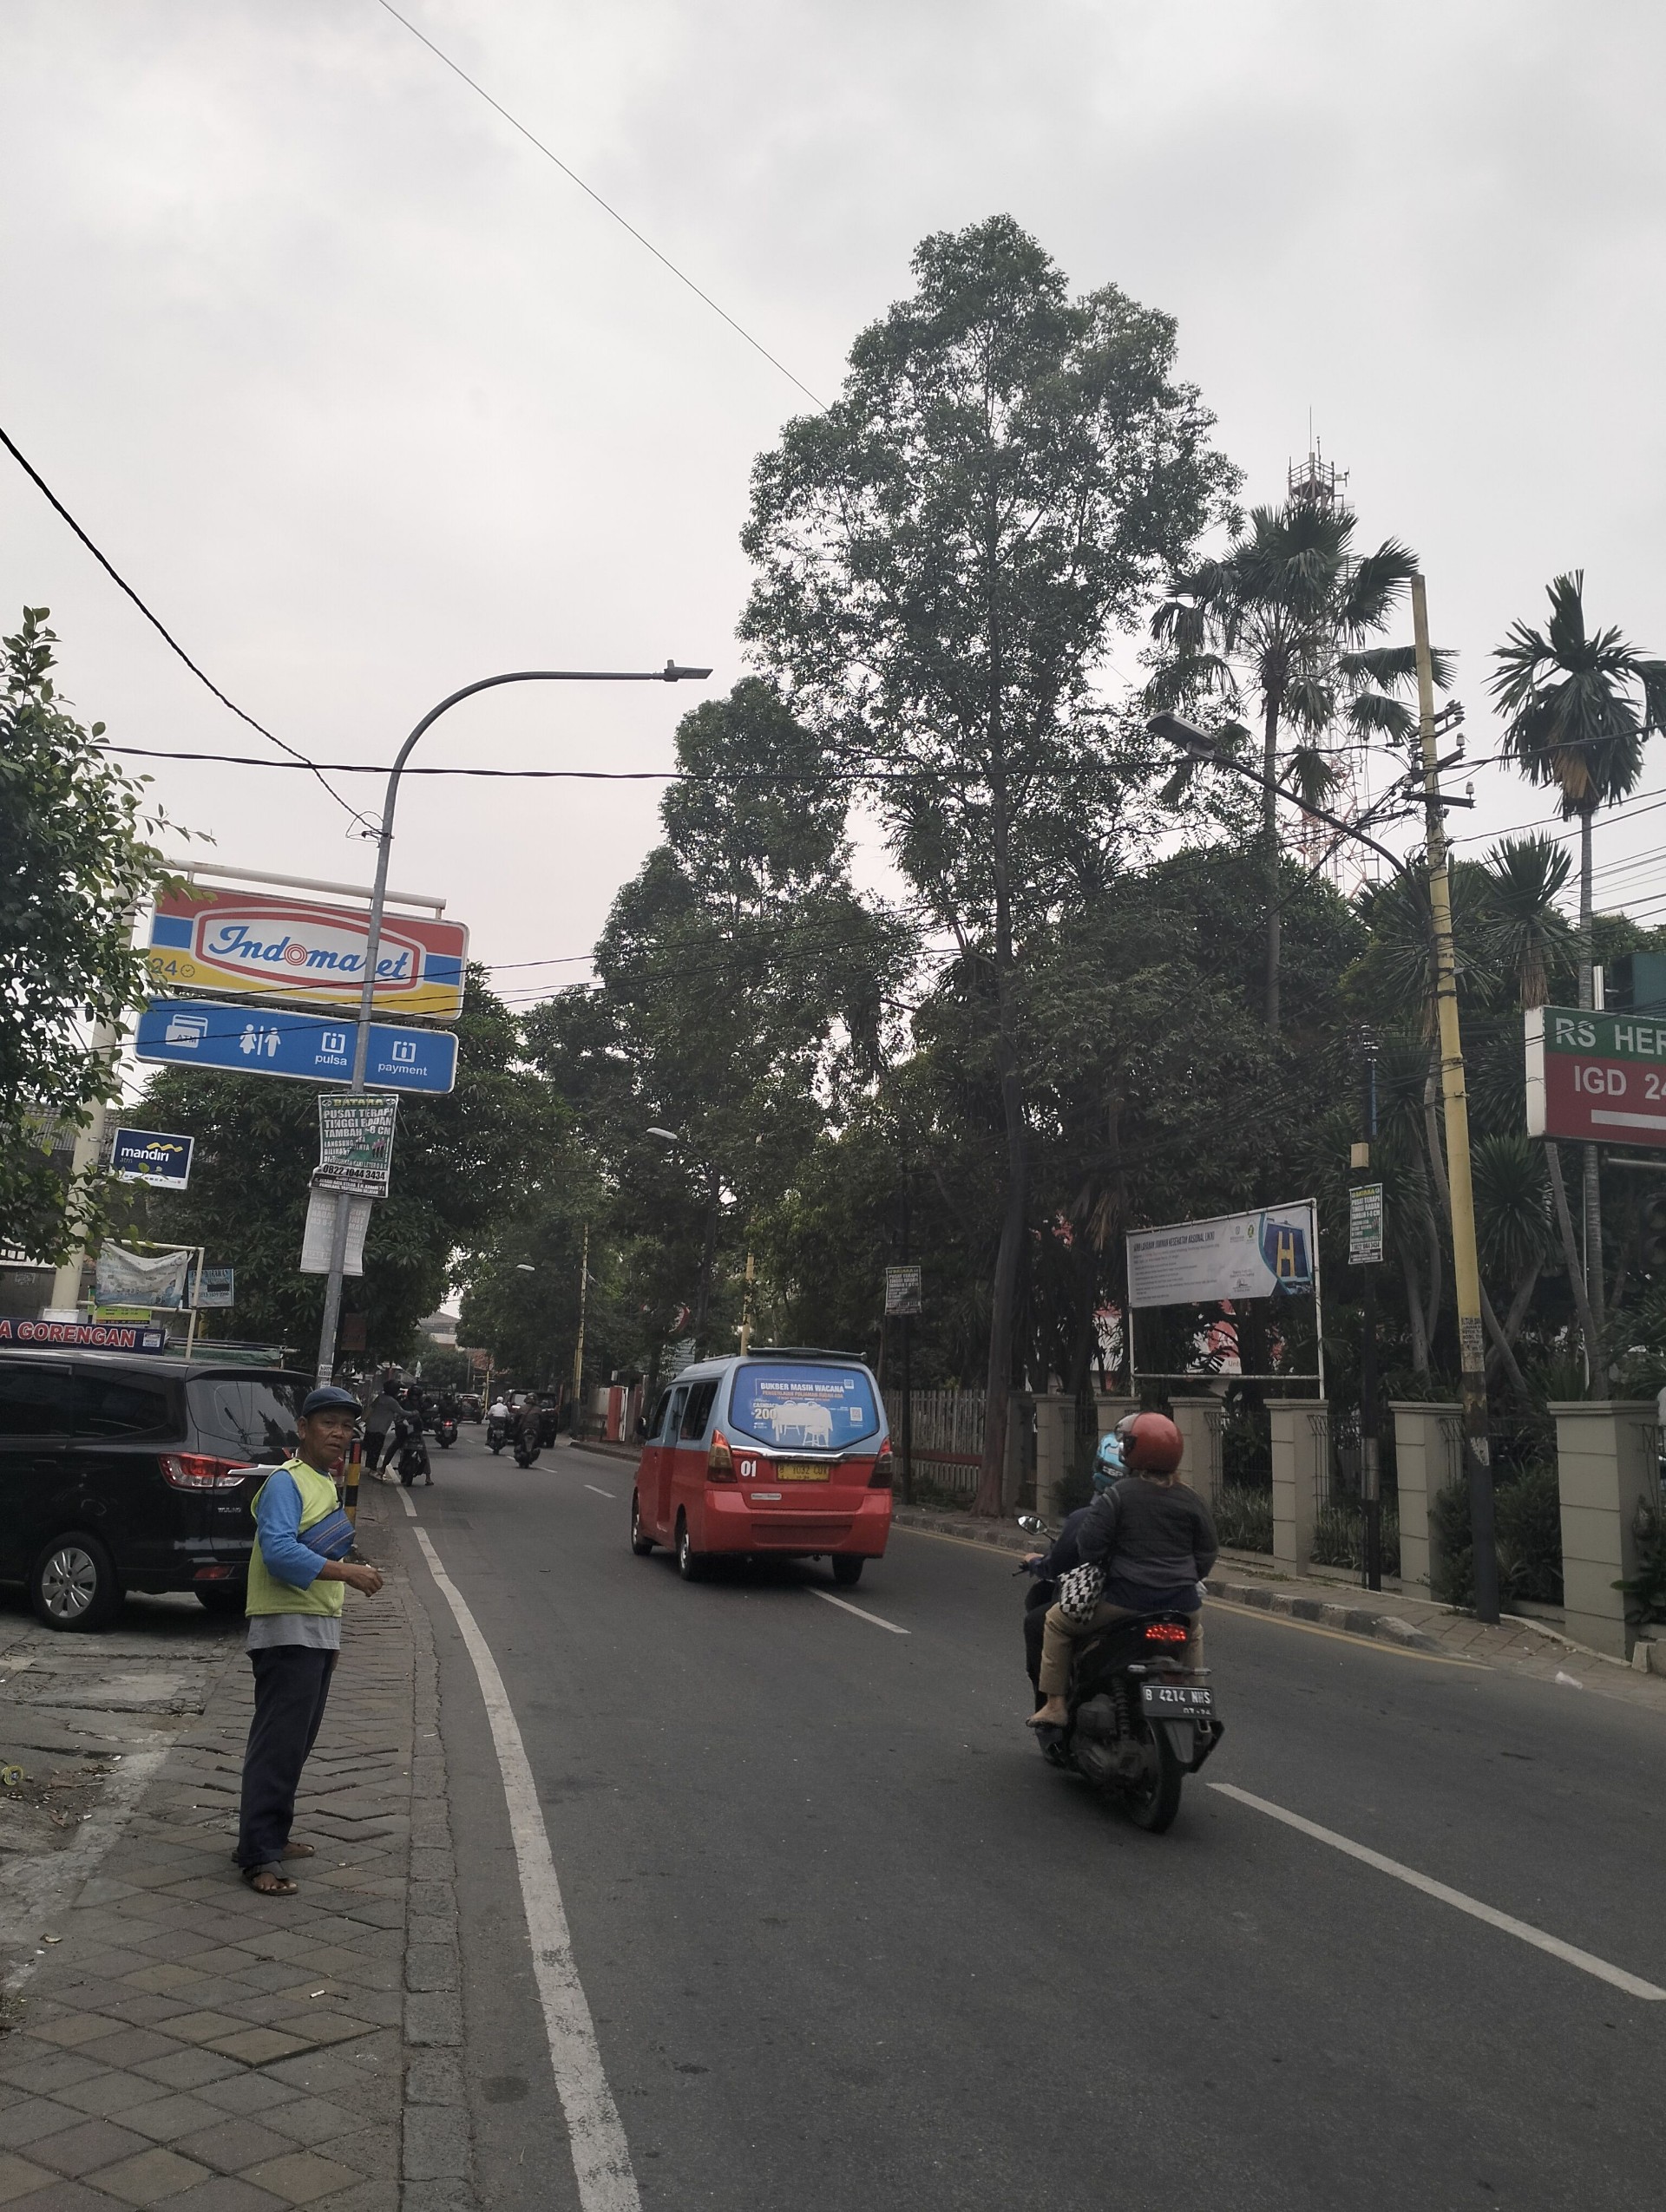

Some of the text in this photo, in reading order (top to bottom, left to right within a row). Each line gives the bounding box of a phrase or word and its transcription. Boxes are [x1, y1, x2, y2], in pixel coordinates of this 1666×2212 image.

[208, 925, 408, 978] Indomaet
[1555, 1018, 1597, 1048] RS
[315, 1054, 347, 1066] pulsa
[377, 1063, 428, 1077] payment
[1574, 1065, 1627, 1096] IGD
[333, 1098, 384, 1107] BATARA
[324, 1108, 393, 1119] PUSAT TERAPI
[324, 1116, 391, 1129] TINGGI BADAN
[324, 1129, 363, 1138] TAMBAH
[377, 1126, 390, 1135] CM
[121, 1147, 170, 1162] mandiri
[0, 1320, 12, 1338] A
[17, 1321, 136, 1347] GORENGAN
[815, 1385, 844, 1394] WACANA
[755, 1408, 777, 1419] 200
[741, 1460, 757, 1477] 01
[1145, 1688, 1210, 1704] B 4214 NHS
